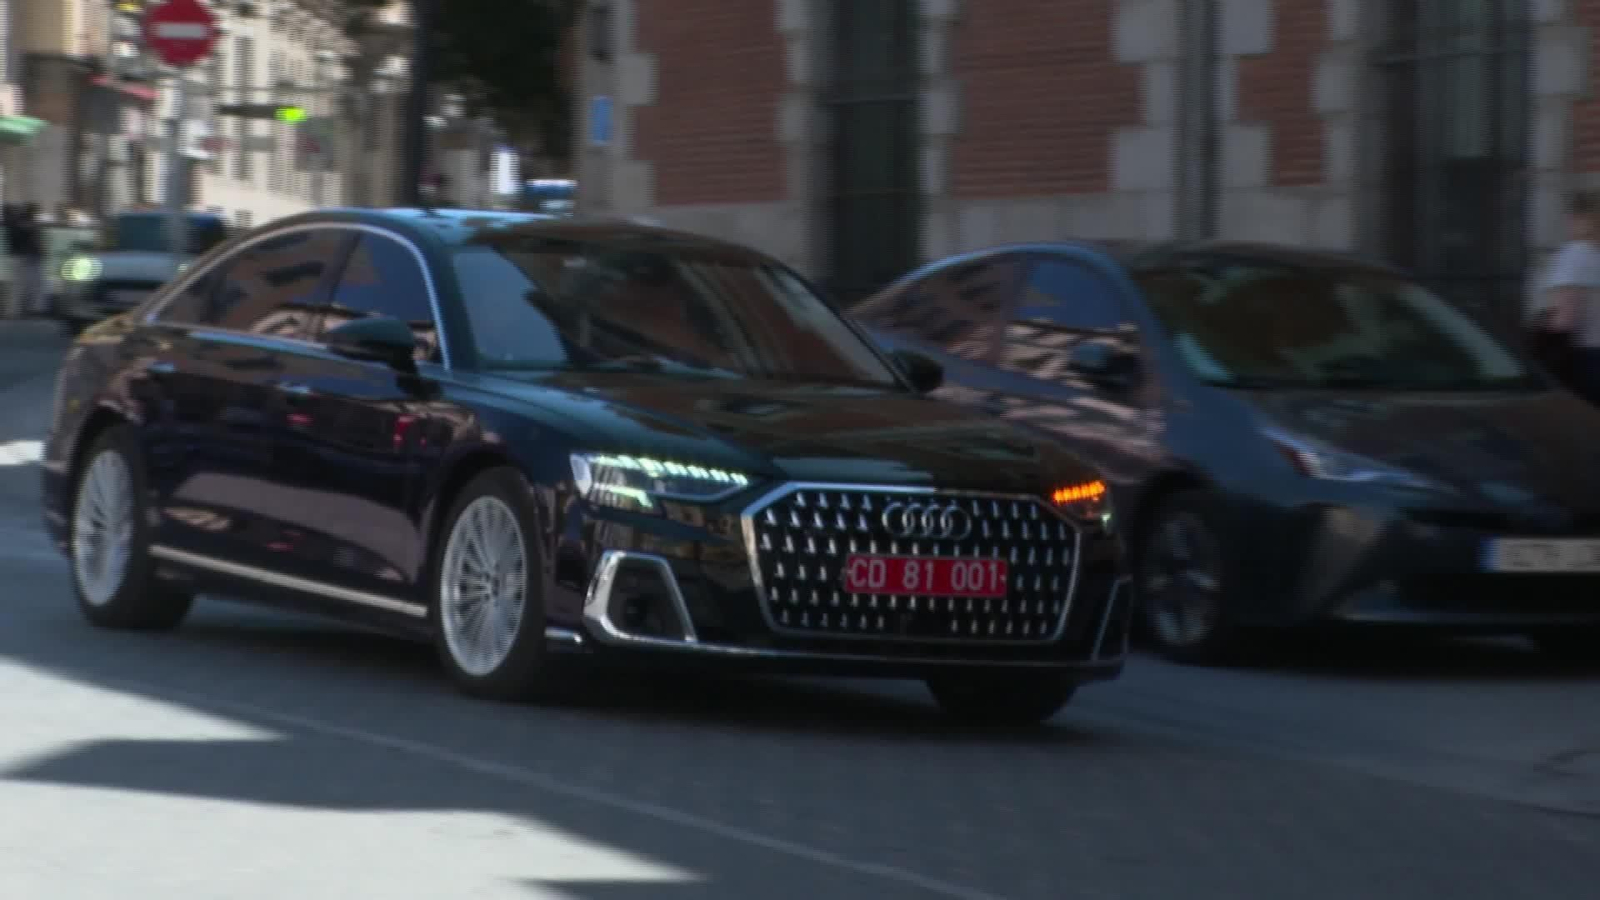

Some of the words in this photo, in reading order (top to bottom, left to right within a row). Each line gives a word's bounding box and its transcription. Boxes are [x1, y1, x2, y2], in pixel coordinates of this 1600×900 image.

[850, 558, 886, 588] CD
[903, 560, 934, 590] 81
[951, 561, 998, 591] 001
